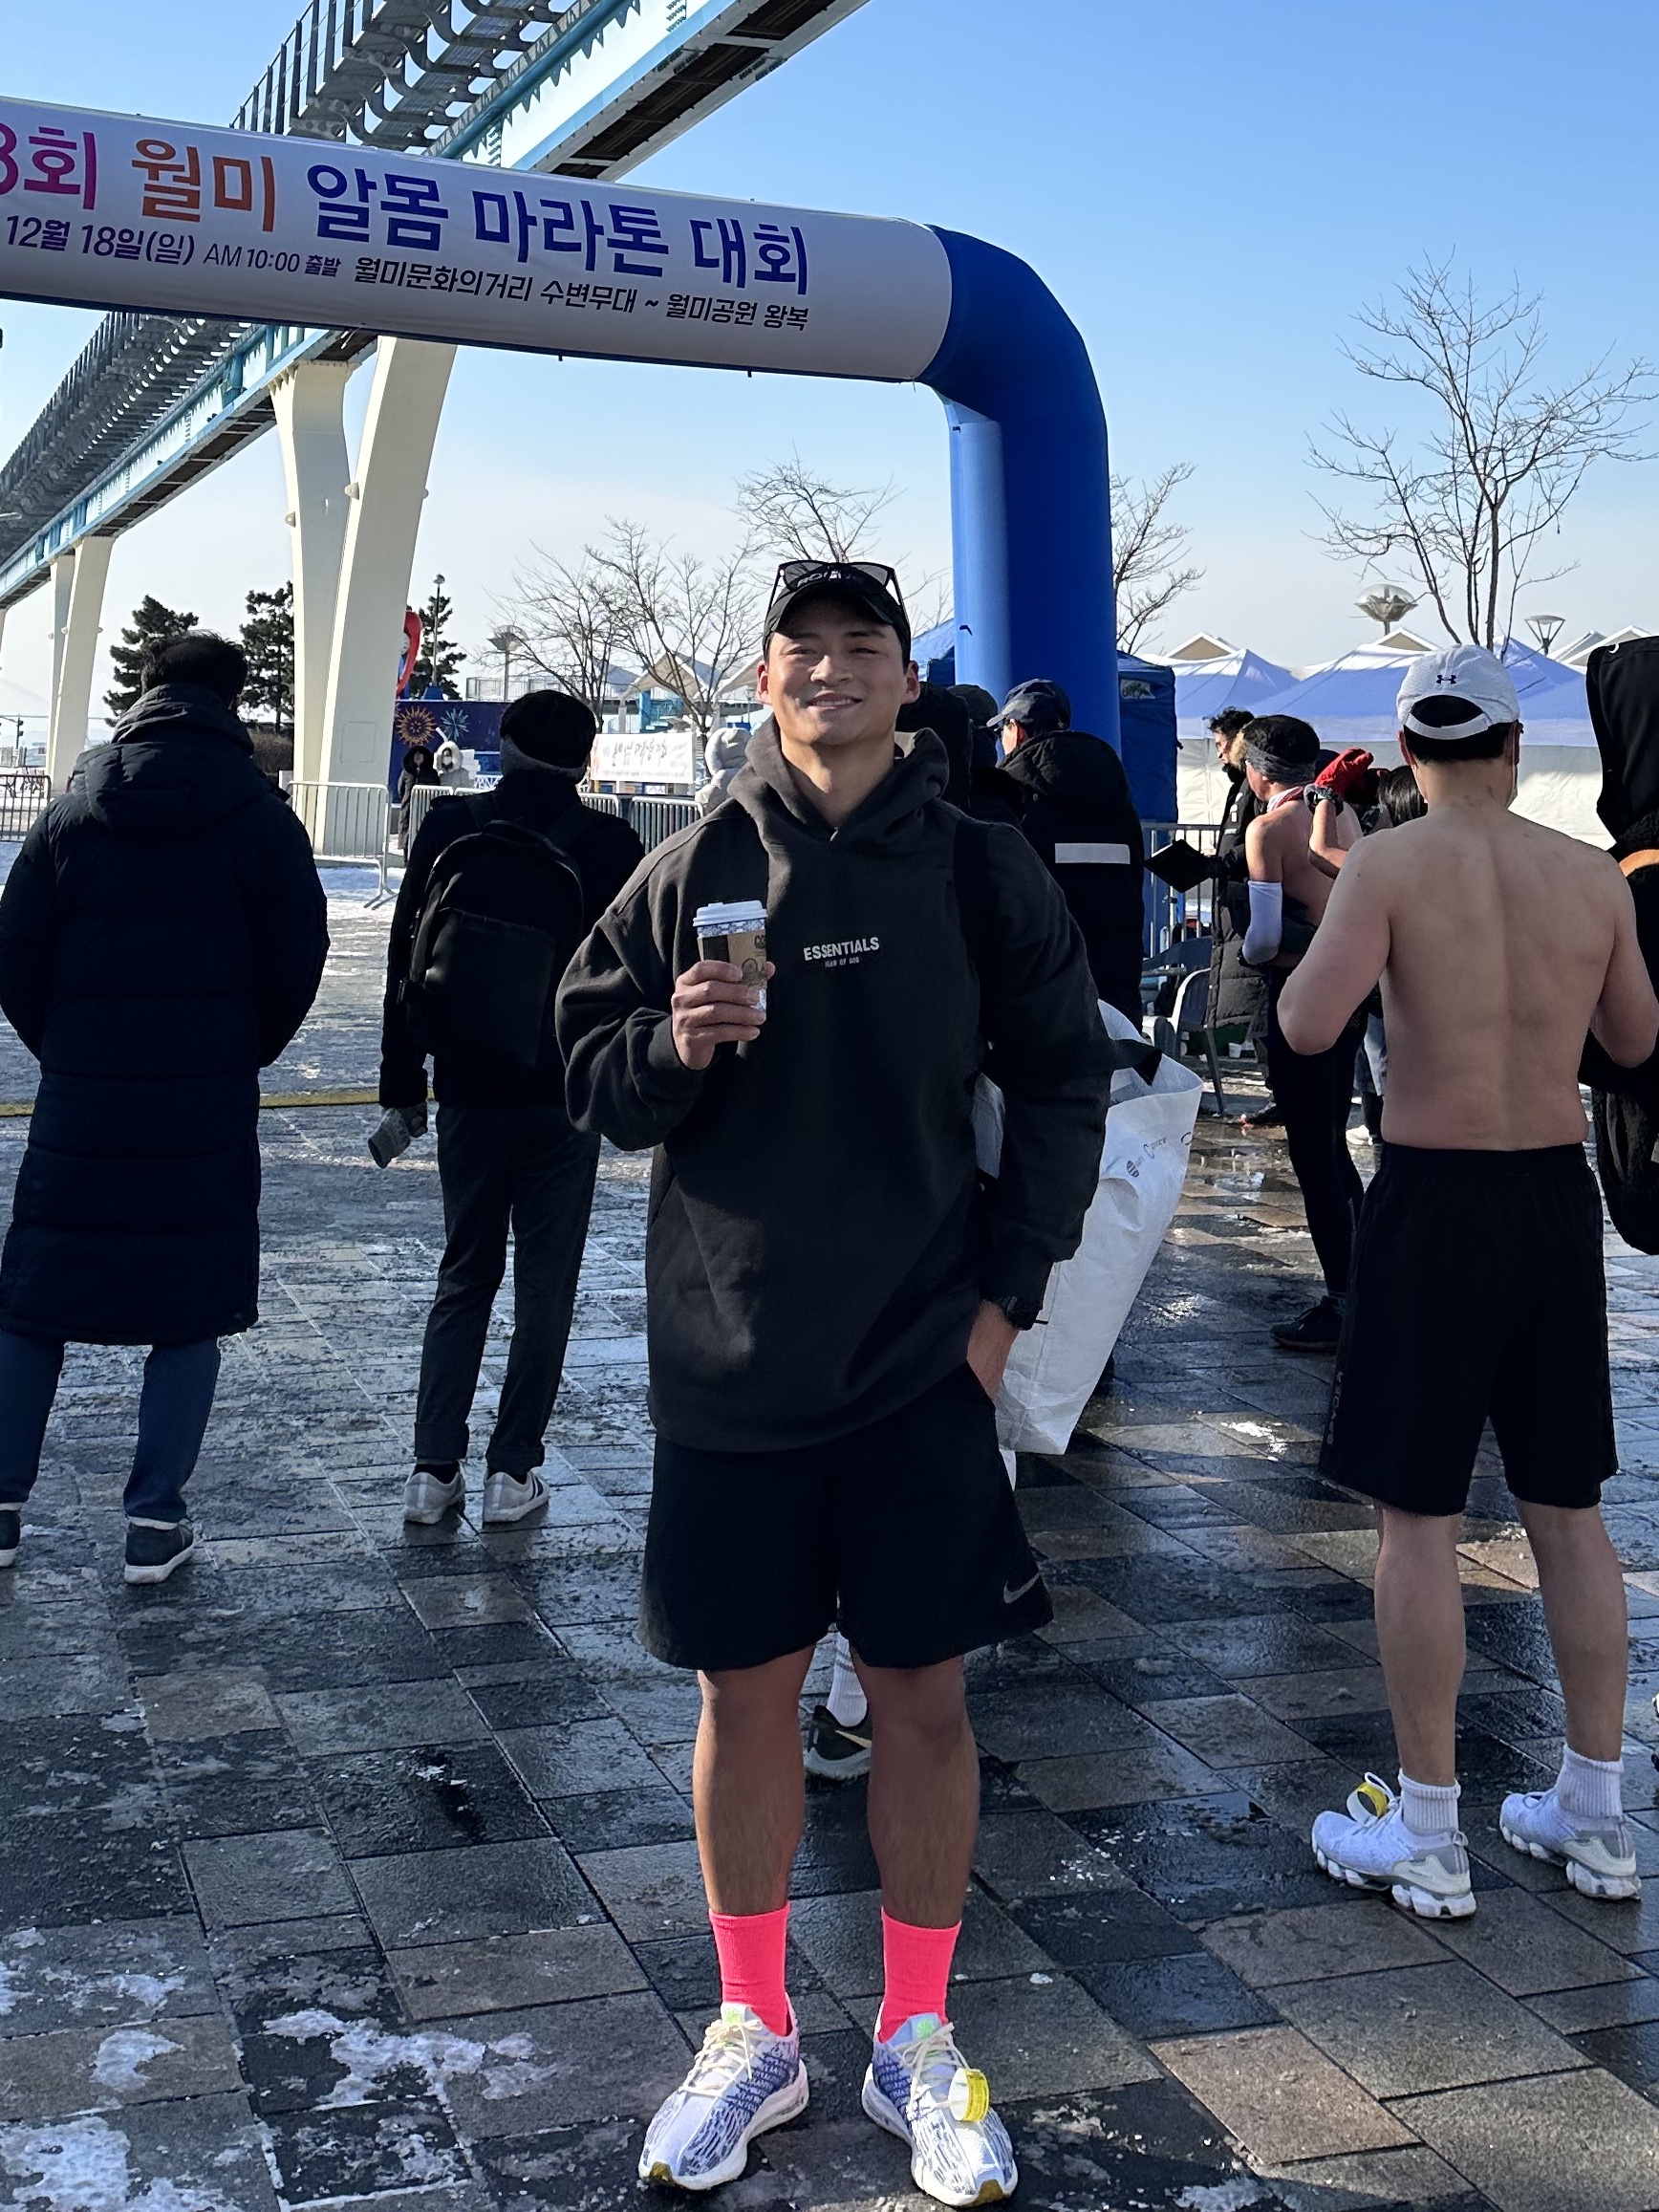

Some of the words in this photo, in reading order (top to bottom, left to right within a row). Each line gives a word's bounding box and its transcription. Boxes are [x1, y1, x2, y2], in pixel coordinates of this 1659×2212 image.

[7, 215, 71, 251] 12월
[81, 225, 195, 266] 18일(일)
[204, 243, 243, 268] AM
[247, 249, 300, 272] 10:00
[305, 254, 342, 277] 출발
[355, 256, 533, 302] 월미문화의거리
[541, 280, 637, 314] 수변무대
[666, 293, 758, 326] 월미공원
[764, 304, 809, 331] 왕복
[132, 140, 275, 232] 월미
[307, 164, 448, 250] 알몸
[472, 190, 669, 277] 마라톤
[690, 218, 809, 295] 대회
[803, 936, 880, 962] ESSENTIALS
